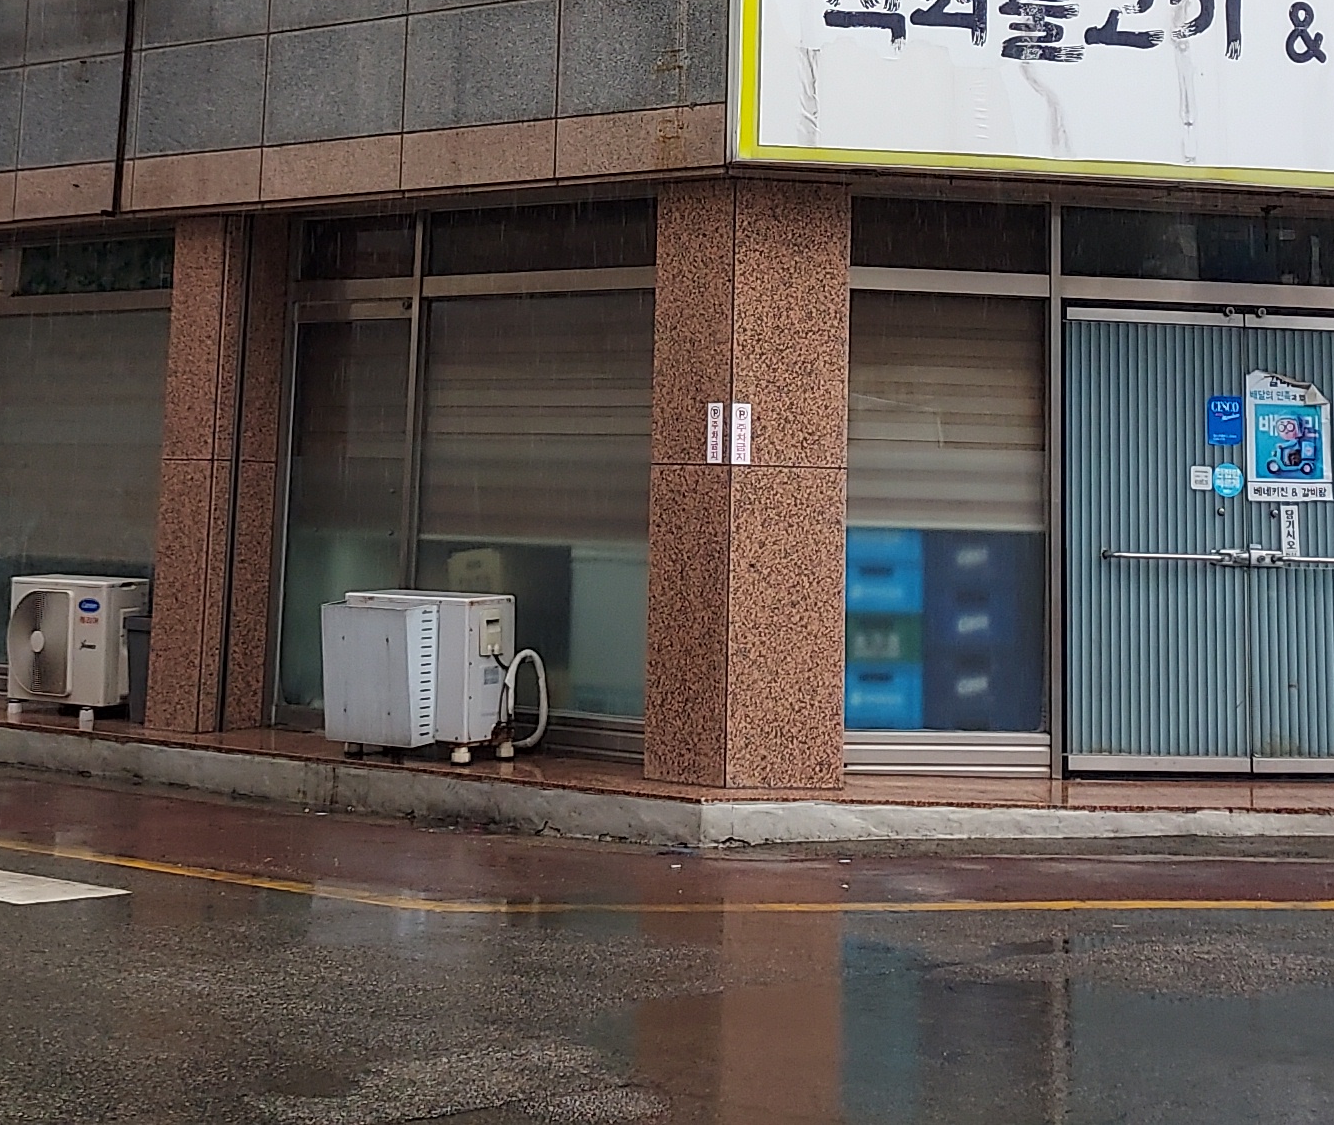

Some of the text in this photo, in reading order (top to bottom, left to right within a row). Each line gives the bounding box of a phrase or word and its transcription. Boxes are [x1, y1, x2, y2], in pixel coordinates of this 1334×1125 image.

[1286, 1, 1327, 64] &
[1211, 401, 1240, 413] CESCO
[710, 420, 719, 461] 주차금지
[736, 424, 747, 462] 주차금지
